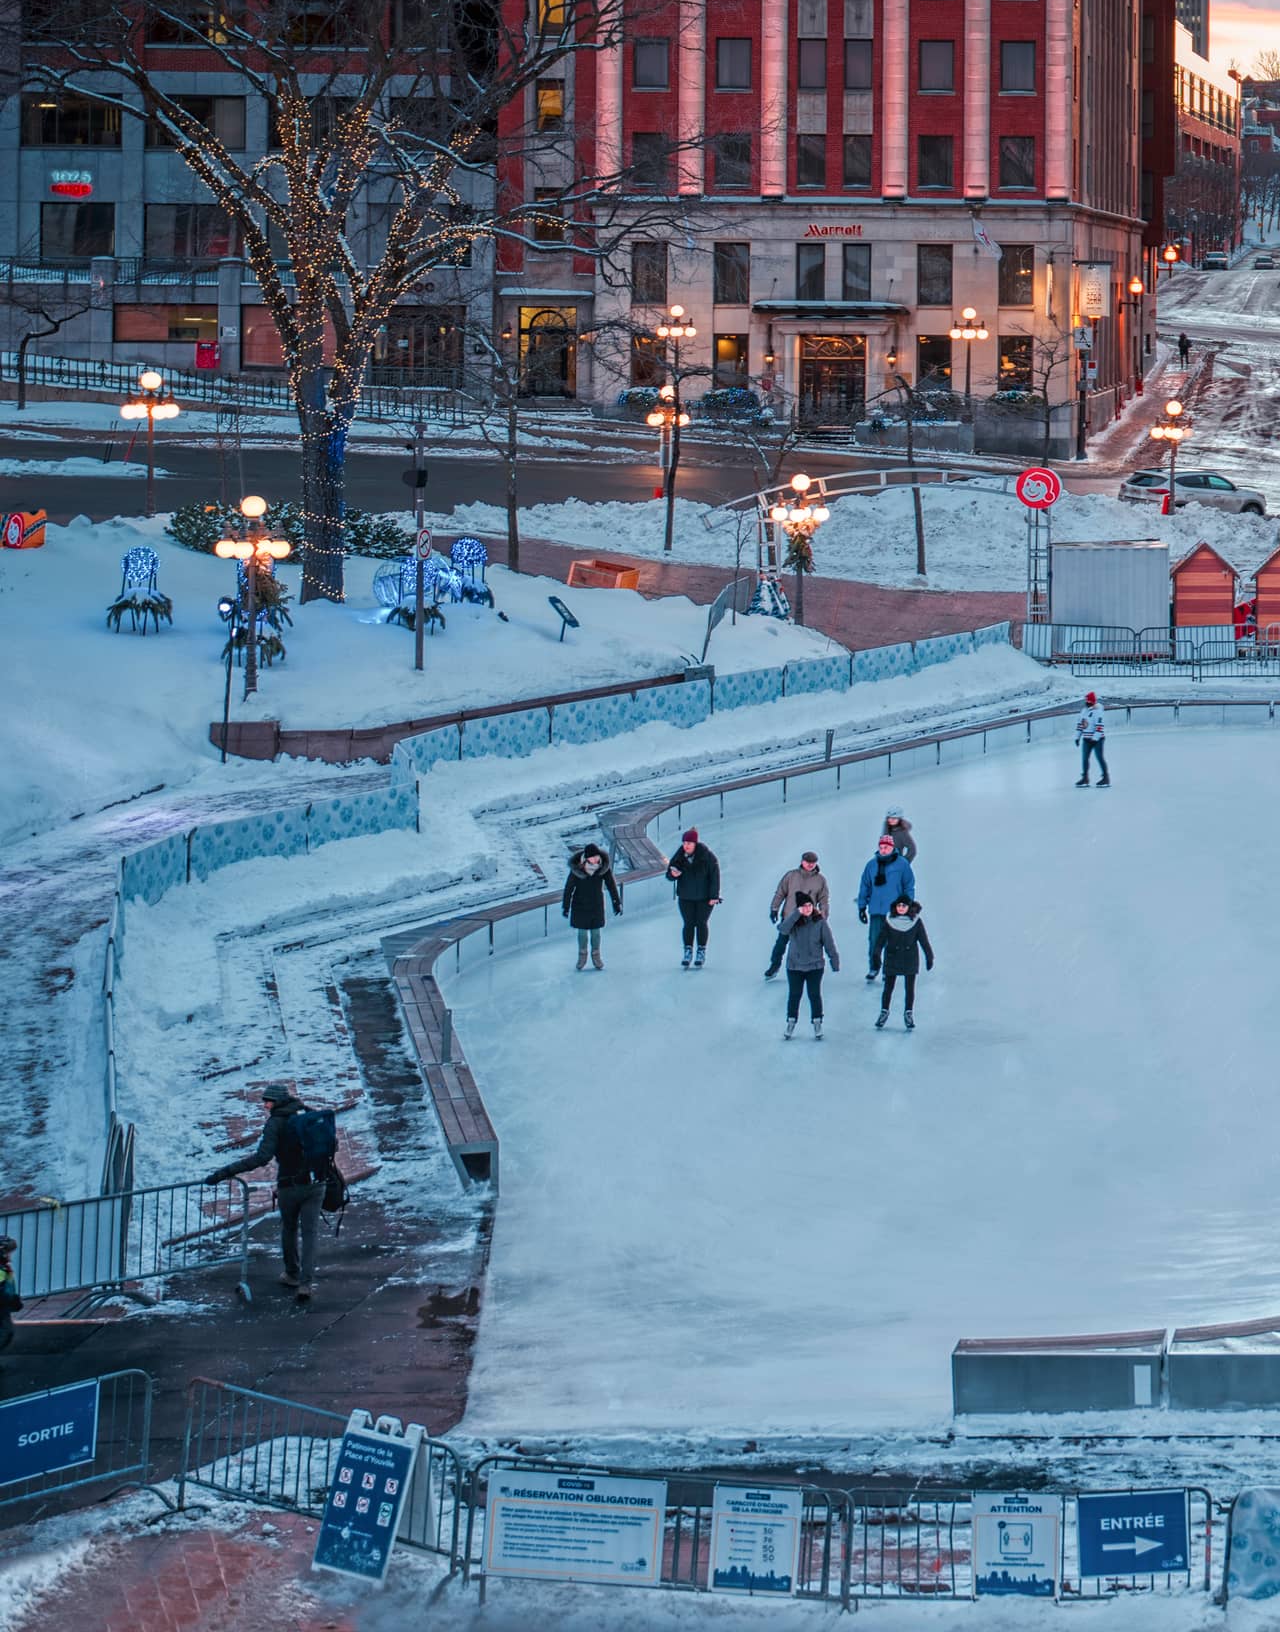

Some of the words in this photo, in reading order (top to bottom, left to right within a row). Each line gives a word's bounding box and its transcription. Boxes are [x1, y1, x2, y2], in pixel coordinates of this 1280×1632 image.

[804, 224, 862, 237] Marriott
[17, 1421, 75, 1447] SORTIE
[344, 1449, 363, 1461] Place
[363, 1455, 395, 1468] d'Youville
[346, 1440, 376, 1454] Patinoire
[376, 1447, 386, 1456] de
[386, 1449, 393, 1458] la
[513, 1487, 584, 1502] RÉSERVATION
[585, 1493, 654, 1506] OBLIGATOIRE
[990, 1505, 1042, 1513] ATTENTION
[1100, 1512, 1165, 1531] ENTRÉE
